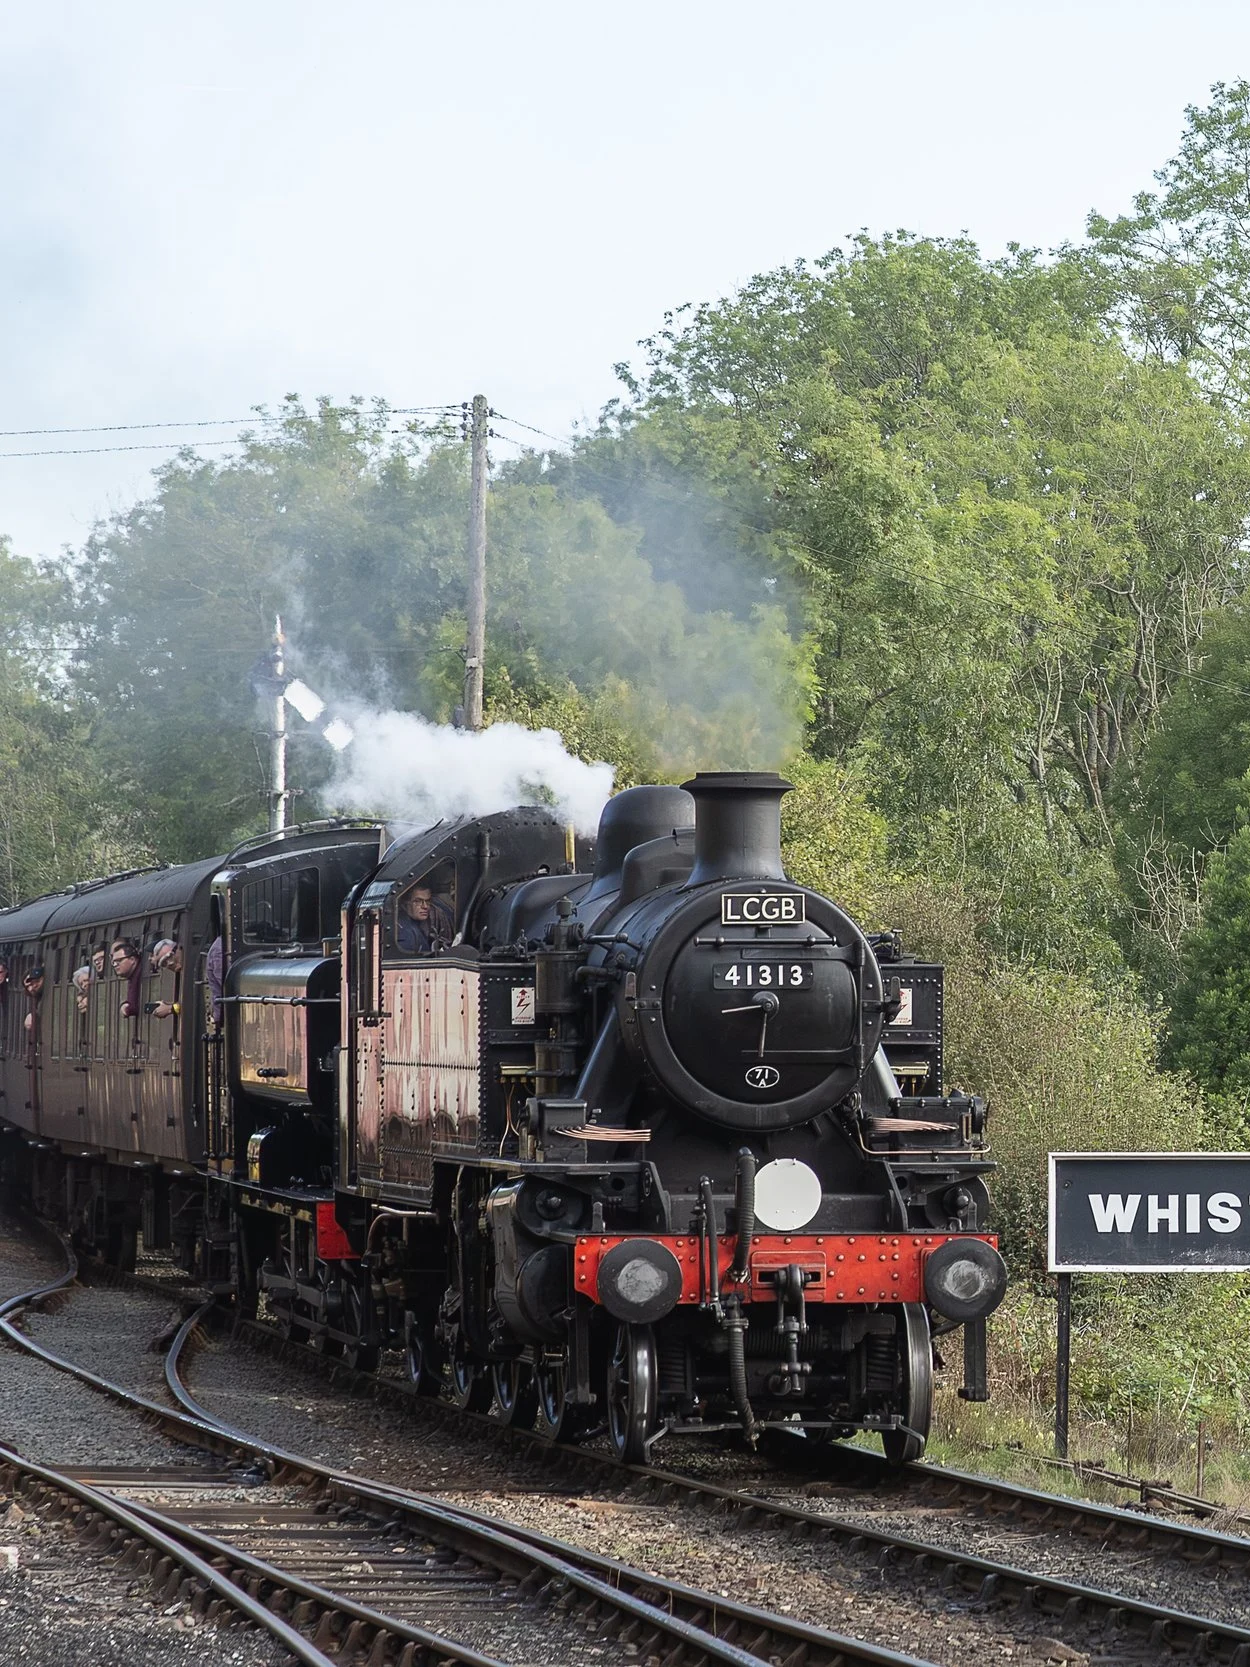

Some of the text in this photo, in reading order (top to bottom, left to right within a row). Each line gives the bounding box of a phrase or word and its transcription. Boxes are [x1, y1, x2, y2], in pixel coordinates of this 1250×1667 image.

[727, 897, 796, 920] LCGB
[724, 964, 804, 986] 41313
[755, 1068, 769, 1079] 71
[758, 1078, 767, 1088] A
